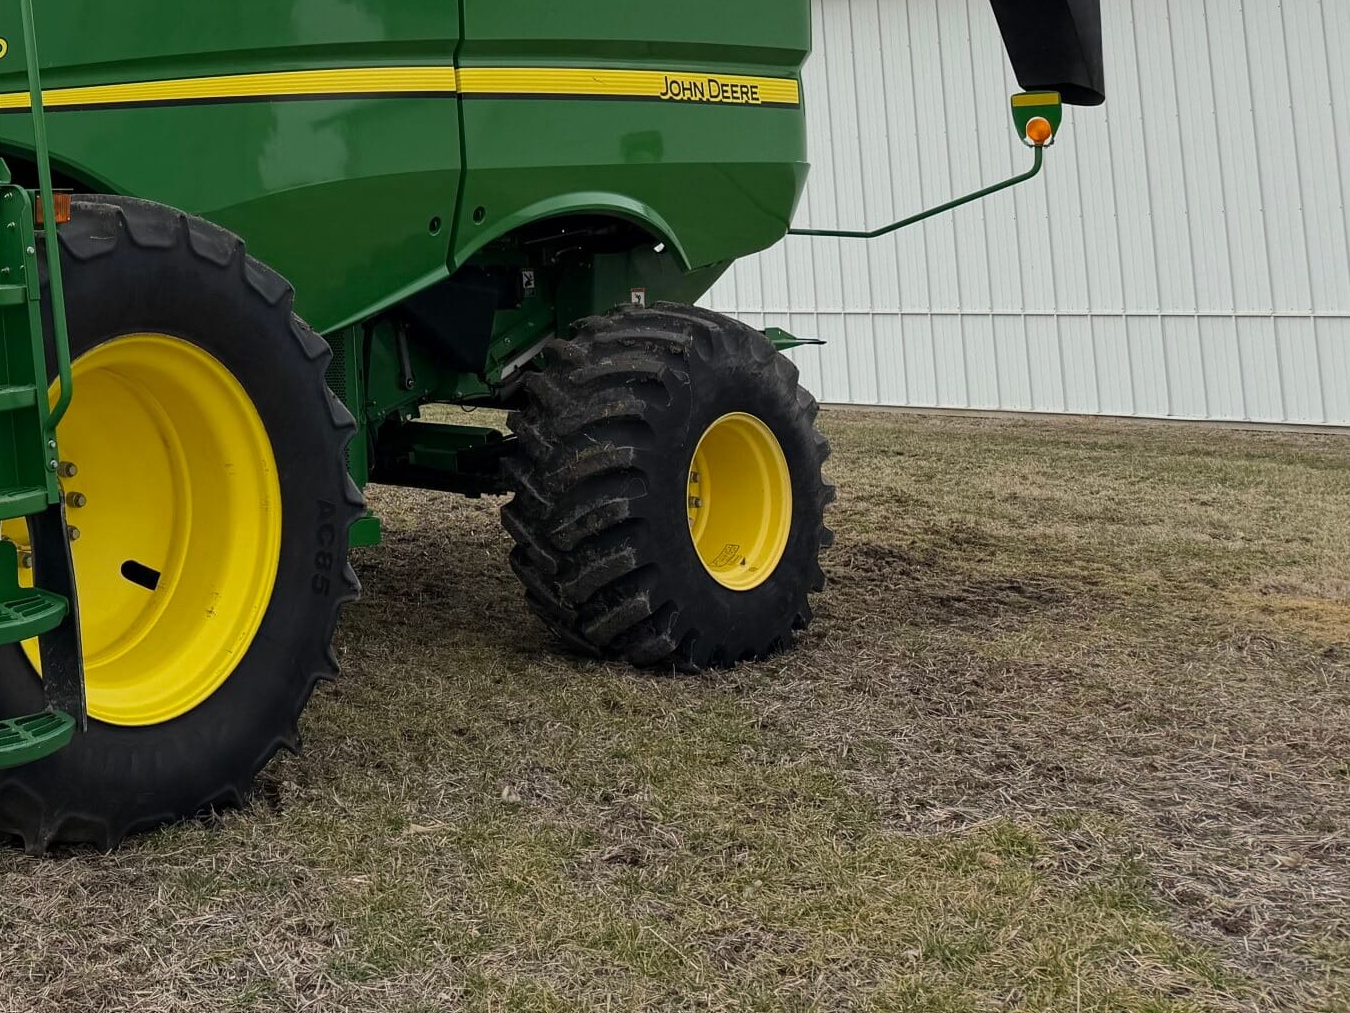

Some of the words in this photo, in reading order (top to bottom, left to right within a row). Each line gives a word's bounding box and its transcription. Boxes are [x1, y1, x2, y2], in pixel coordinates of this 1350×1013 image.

[659, 75, 705, 99] JOHN
[707, 78, 760, 101] DEERE
[311, 498, 338, 597] AC85
